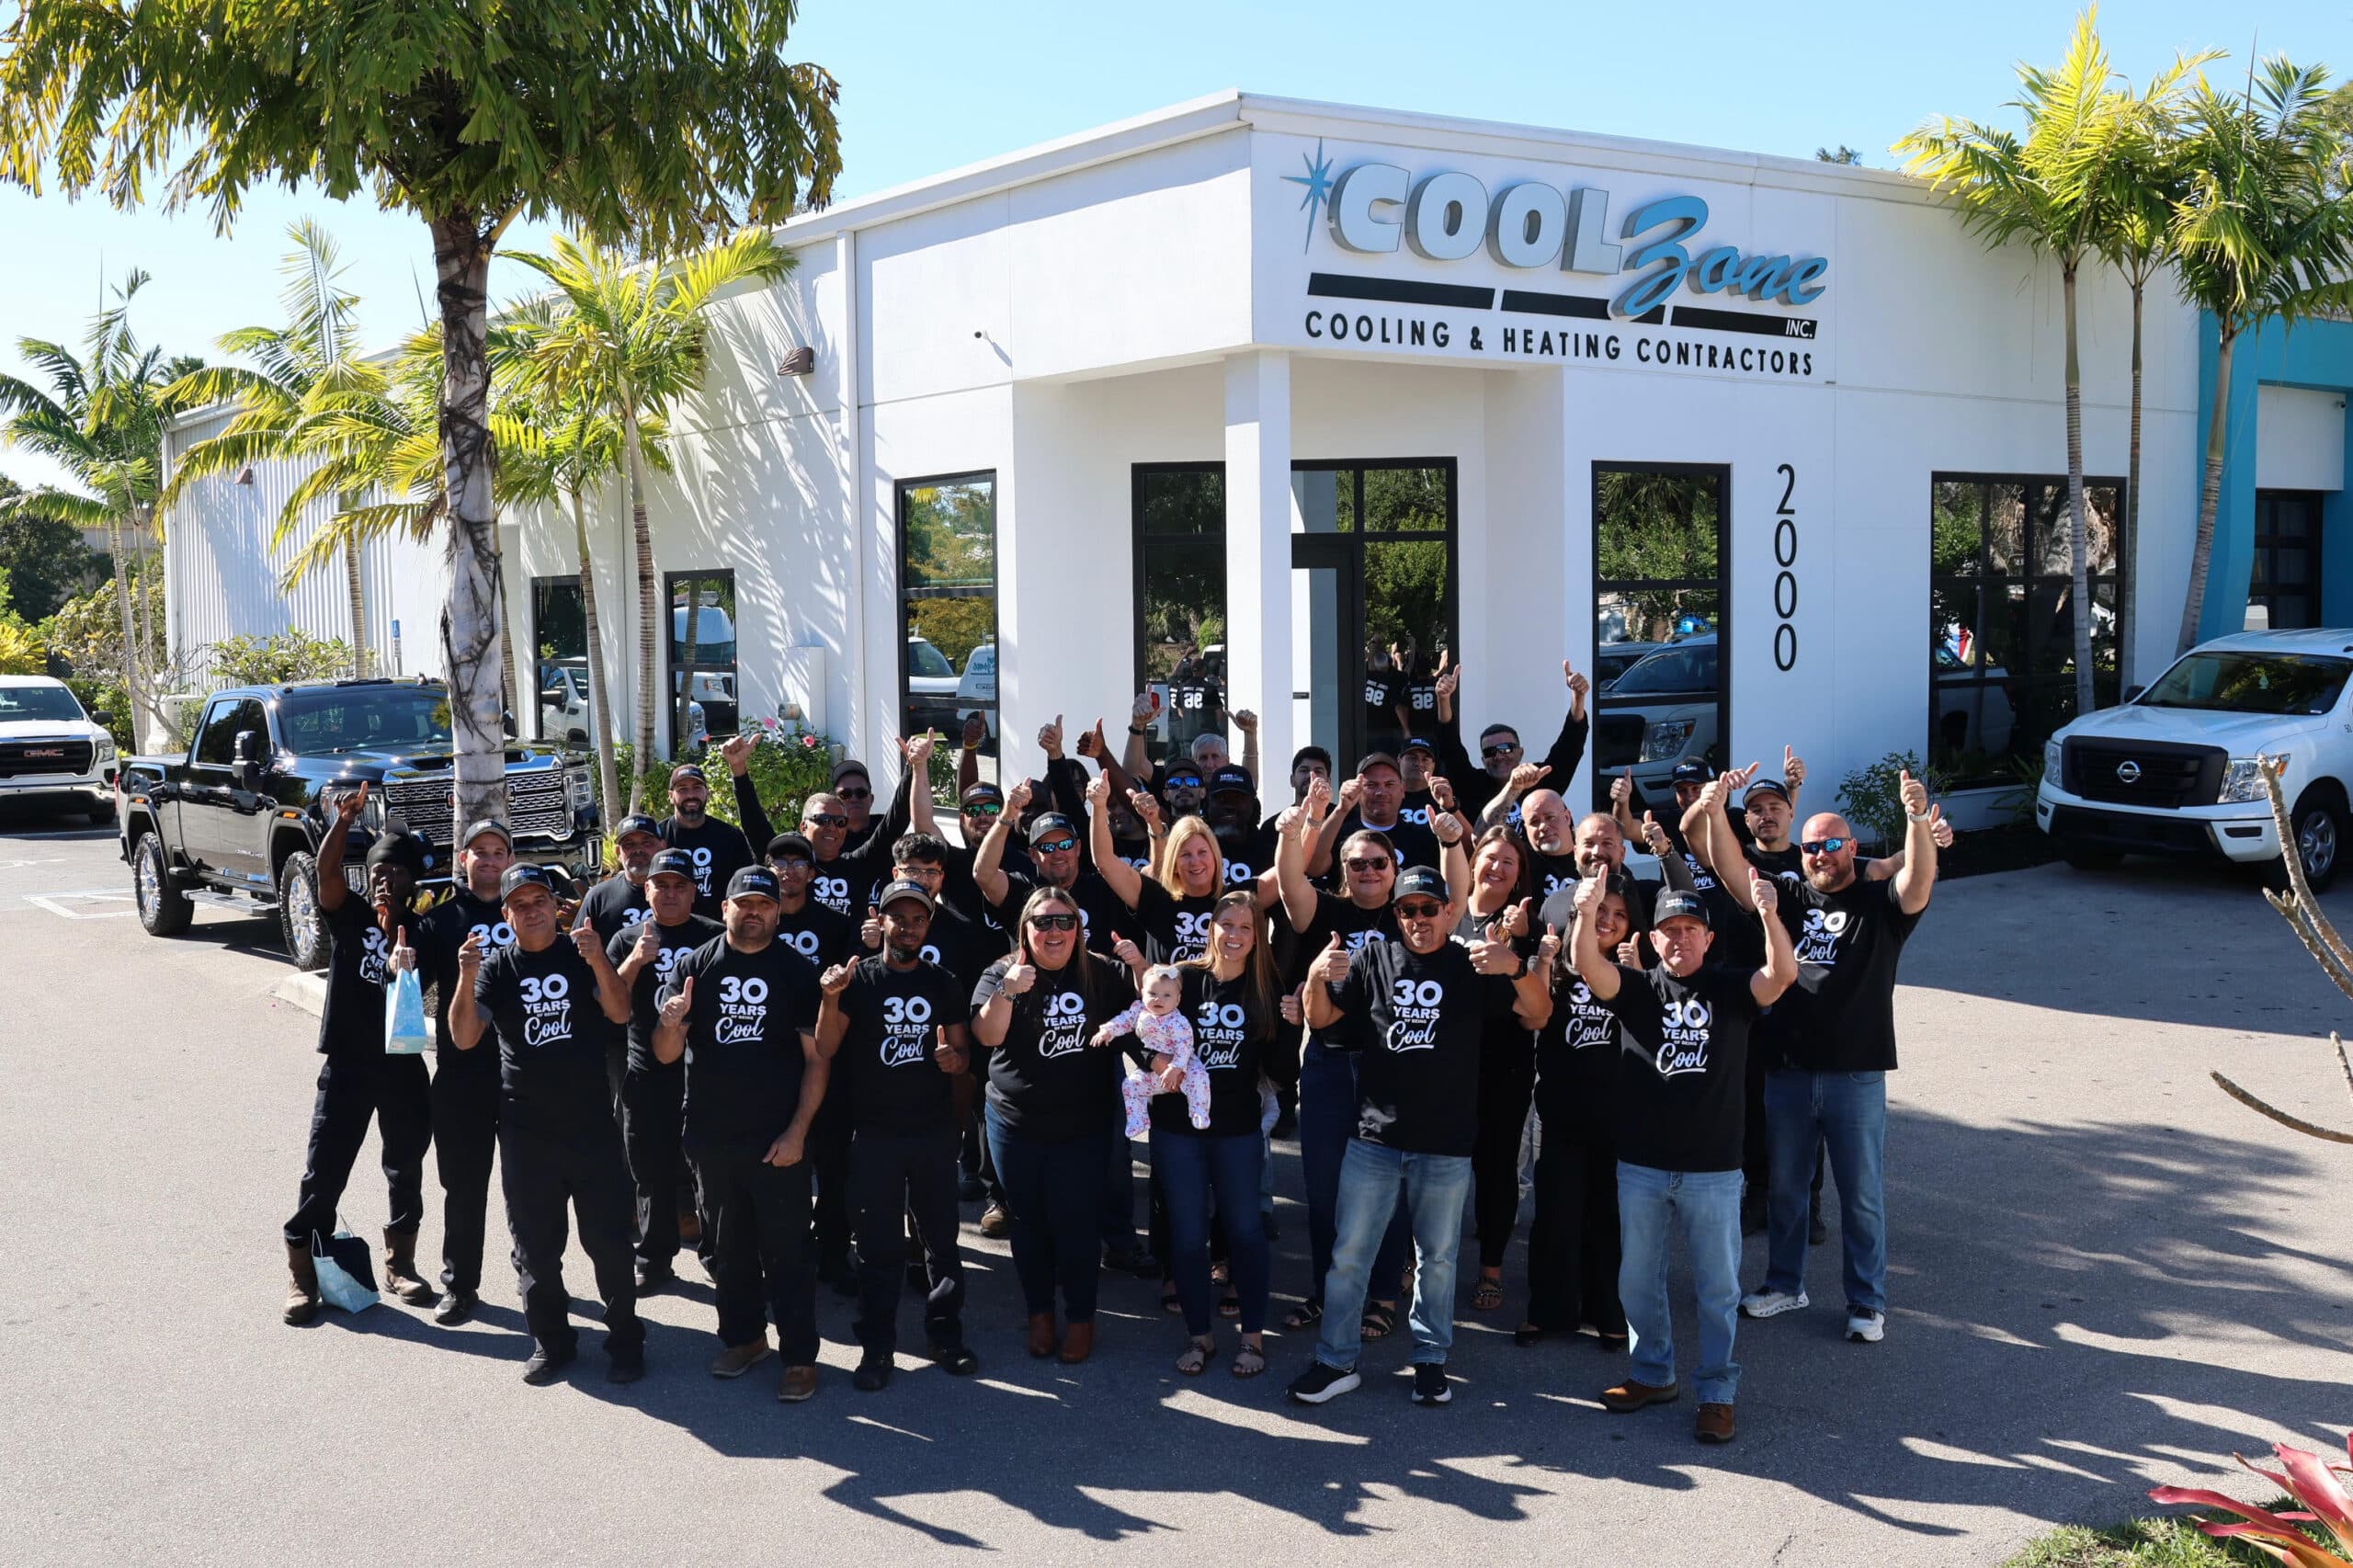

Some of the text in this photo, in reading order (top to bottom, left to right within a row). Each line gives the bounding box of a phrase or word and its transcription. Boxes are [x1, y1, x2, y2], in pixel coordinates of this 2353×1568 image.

[1328, 163, 1828, 316] COOL Zone
[1785, 319, 1813, 337] INC.
[1305, 311, 1812, 376] COOLING & HEATING CONTRACTORS
[1774, 463, 1797, 672] 2000
[23, 749, 64, 757] GMC
[1399, 809, 1428, 824] 30
[814, 876, 848, 897] 30
[1803, 908, 1847, 932] 30
[1176, 934, 1208, 944] YEAR
[1793, 936, 1837, 963] Cool
[519, 973, 569, 1003] 30
[720, 976, 768, 1004] 30
[1392, 979, 1447, 1007] 30
[523, 999, 571, 1015] YEARS
[720, 1003, 767, 1016] YEARS
[883, 995, 931, 1023] 30
[1043, 992, 1084, 1017] 30
[1197, 1002, 1245, 1028] 30
[1392, 1006, 1440, 1019] YEARS
[1662, 999, 1708, 1028] 30
[525, 1009, 572, 1046] Cool
[715, 1016, 764, 1044] Cool
[884, 1024, 930, 1034] YEARS
[1043, 1013, 1086, 1027] YEARS
[1565, 1017, 1611, 1048] Cool
[1662, 1027, 1709, 1040] YEARS
[1039, 1023, 1086, 1058] Cool
[1198, 1028, 1245, 1040] YEARS
[1386, 1019, 1436, 1051] Cool
[880, 1033, 924, 1066] Cool
[1198, 1040, 1240, 1069] Cool
[1656, 1040, 1708, 1075] Cool
